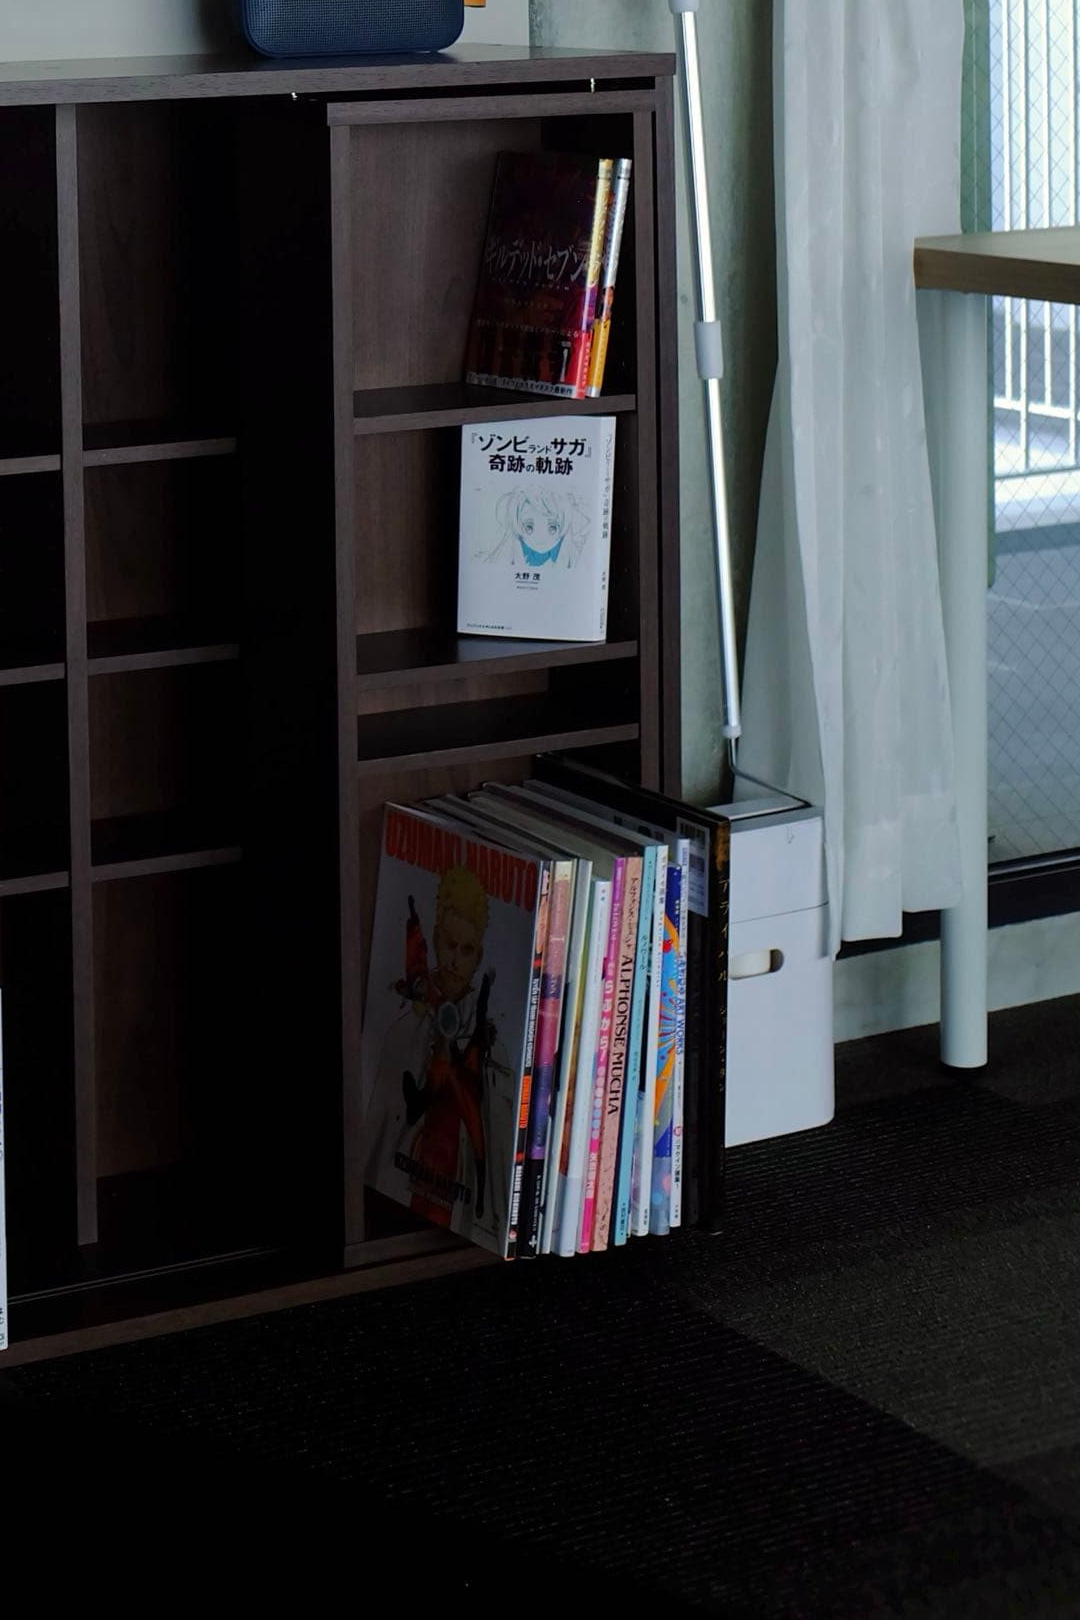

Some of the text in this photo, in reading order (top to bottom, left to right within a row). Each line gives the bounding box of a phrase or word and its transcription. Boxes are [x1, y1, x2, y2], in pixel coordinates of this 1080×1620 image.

[489, 454, 574, 476] 奇跡の軌跡
[466, 840, 537, 912] NARUTO
[612, 954, 633, 1046] ALPHONSE
[675, 1019, 684, 1055] WORKS
[607, 1049, 624, 1117] MUCHA
